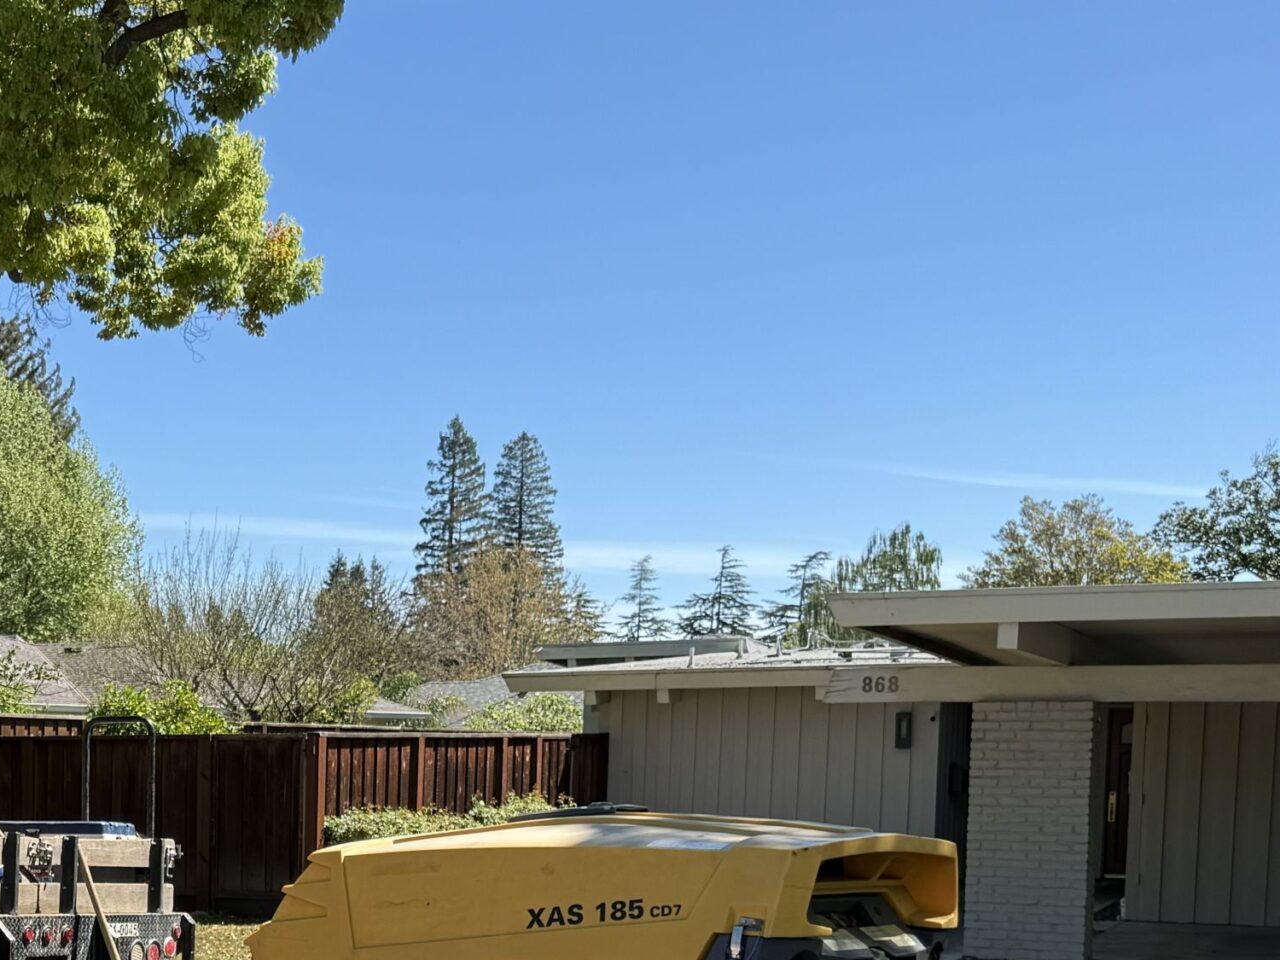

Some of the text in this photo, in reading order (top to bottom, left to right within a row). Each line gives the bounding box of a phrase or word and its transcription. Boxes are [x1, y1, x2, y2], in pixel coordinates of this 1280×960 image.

[862, 675, 899, 693] 868
[526, 899, 682, 929] XAS 185 CD7
